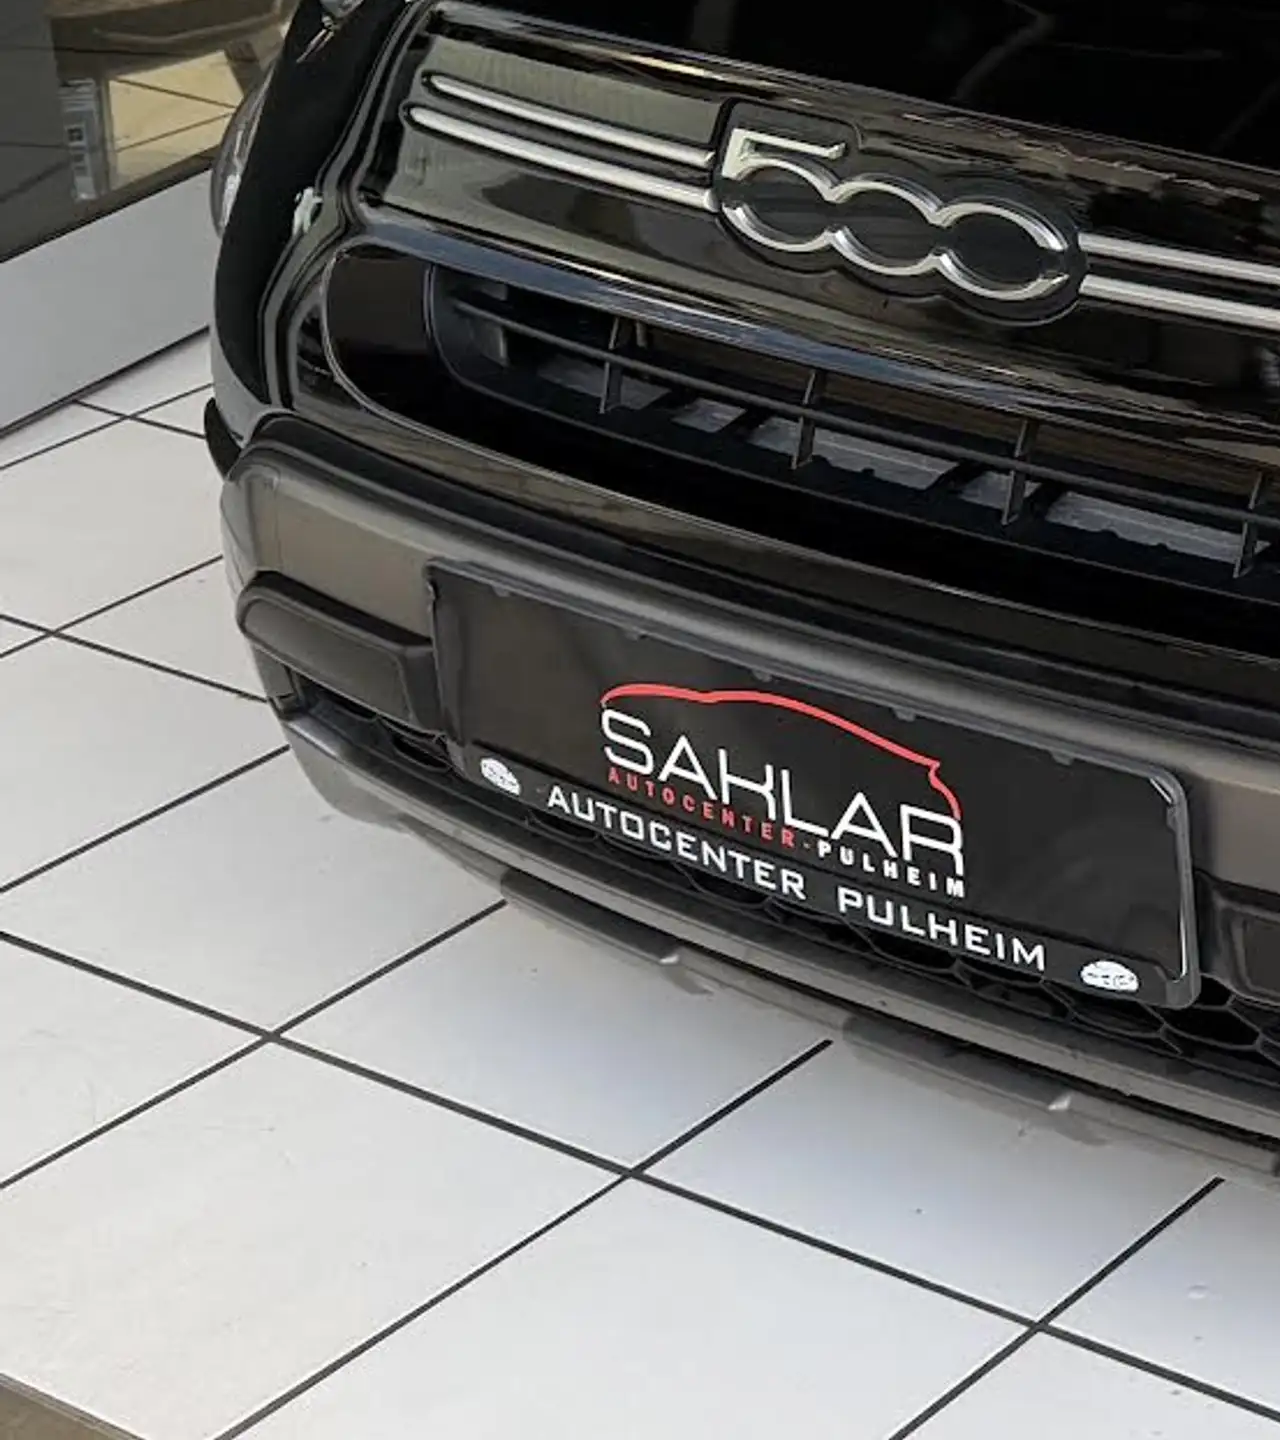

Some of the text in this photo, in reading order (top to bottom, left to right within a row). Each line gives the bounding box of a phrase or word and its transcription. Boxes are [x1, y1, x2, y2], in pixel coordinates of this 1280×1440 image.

[721, 127, 1071, 301] 500
[547, 784, 1045, 972] AUTOCENTER PULHEIM
